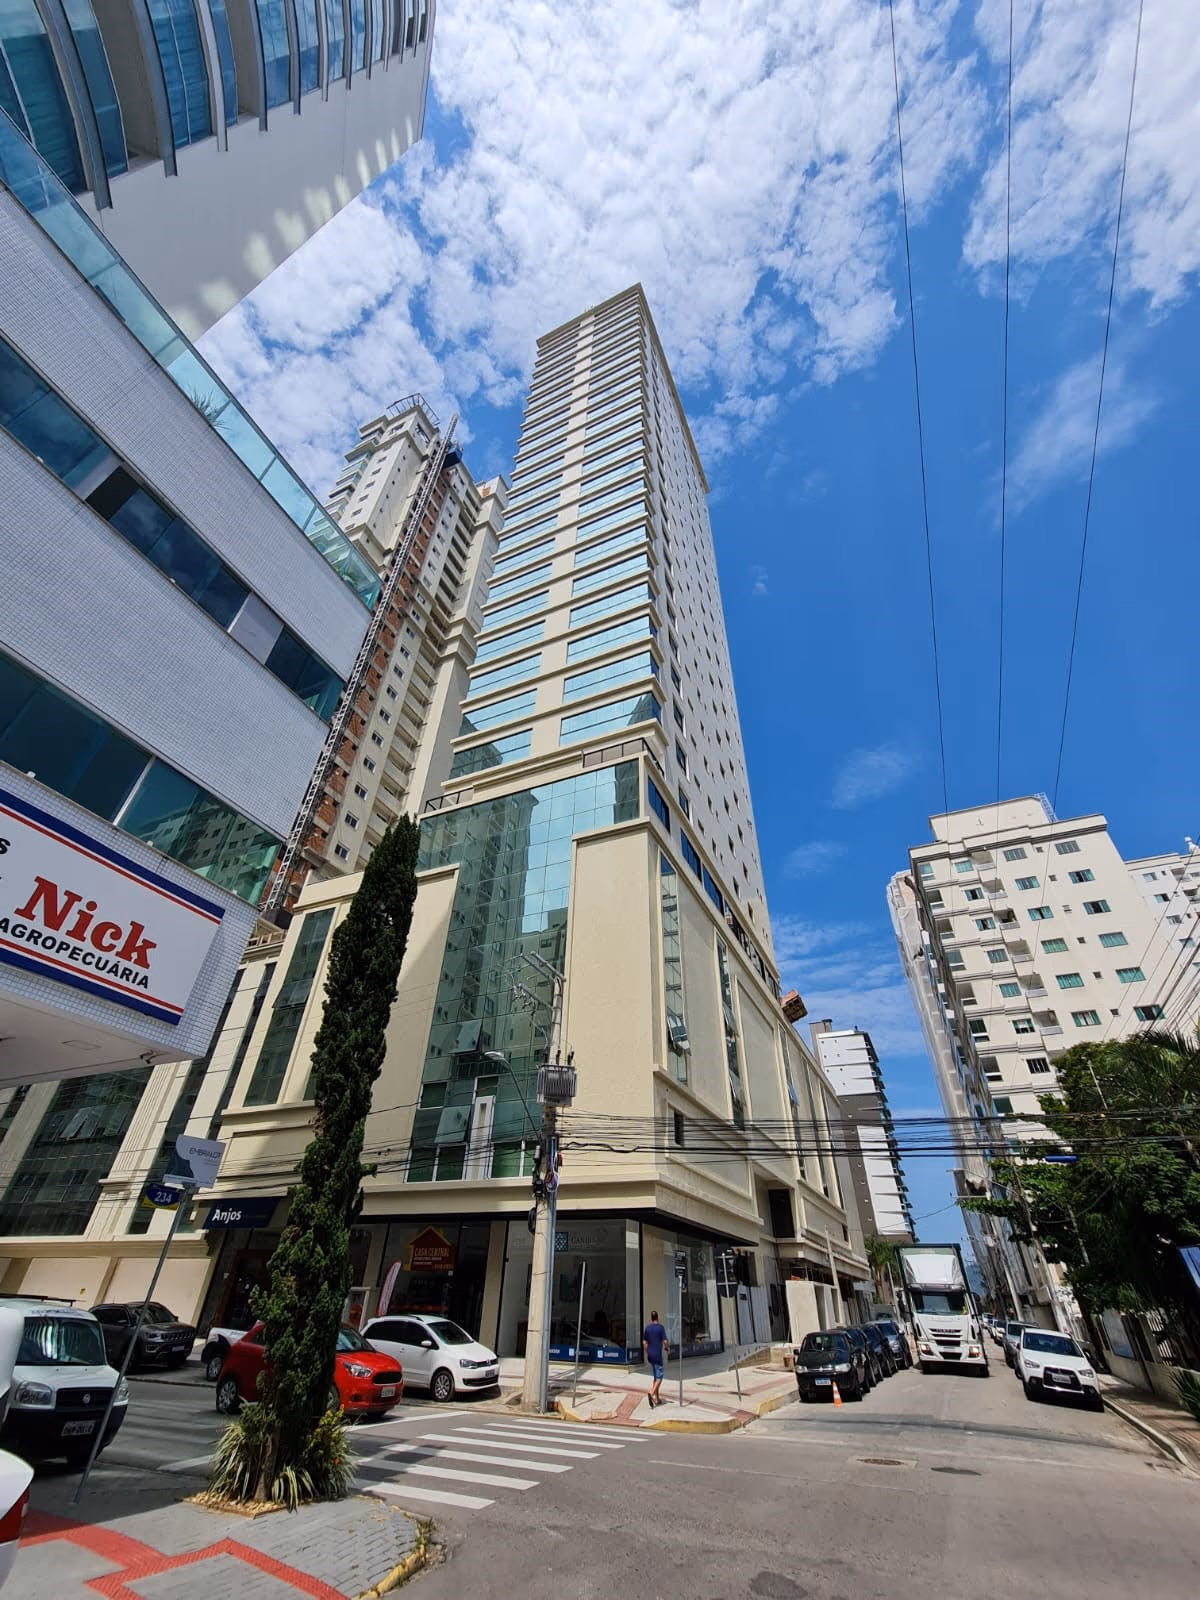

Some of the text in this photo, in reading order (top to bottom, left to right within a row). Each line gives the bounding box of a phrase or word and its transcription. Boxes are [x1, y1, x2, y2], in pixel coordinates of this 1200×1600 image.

[14, 875, 157, 969] Nick
[0, 917, 149, 989] AGROPECUÁRIA
[154, 1191, 172, 1203] 234
[212, 1207, 242, 1224] Anjos
